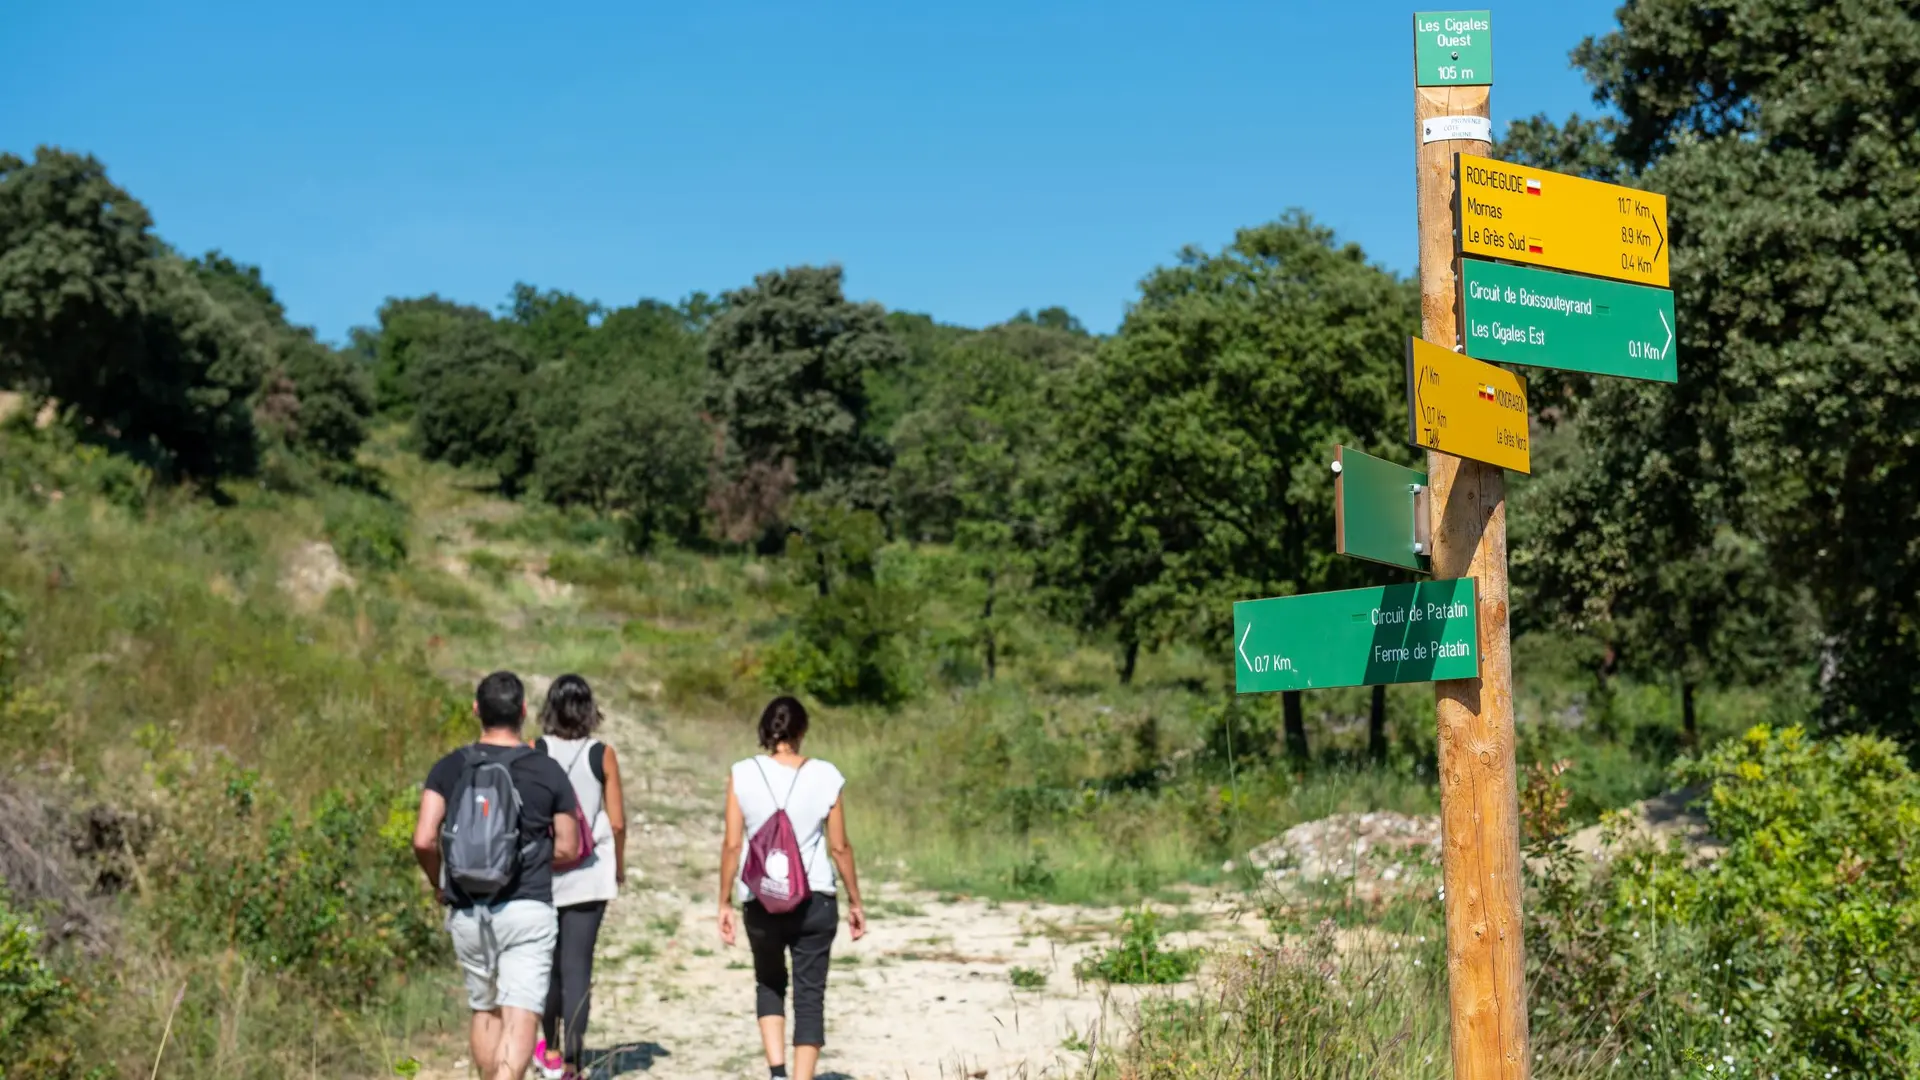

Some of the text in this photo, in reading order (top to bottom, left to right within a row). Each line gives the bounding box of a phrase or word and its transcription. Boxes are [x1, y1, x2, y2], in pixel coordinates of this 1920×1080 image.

[1418, 17, 1489, 35] Les Cigales
[1437, 33, 1472, 47] Ouest
[1438, 66, 1474, 80] 105 m
[1466, 165, 1524, 194] ROCHEGUDE
[1467, 196, 1503, 219] Mornas
[1635, 201, 1650, 219] Km
[1468, 225, 1526, 252] Le Grès Sud
[1636, 229, 1651, 247] Km
[1637, 256, 1652, 273] Km
[1470, 280, 1592, 316] Circuit de Boissouteyrand
[1471, 319, 1545, 346] Les Cigales Est
[1643, 341, 1660, 361] Km
[1430, 367, 1440, 386] Km
[1437, 408, 1447, 428] Km
[1496, 425, 1503, 444] Le
[1371, 600, 1468, 626] Circuit de Patatin
[1375, 638, 1470, 663] Ferme de Patatin
[1273, 653, 1291, 671] Km
